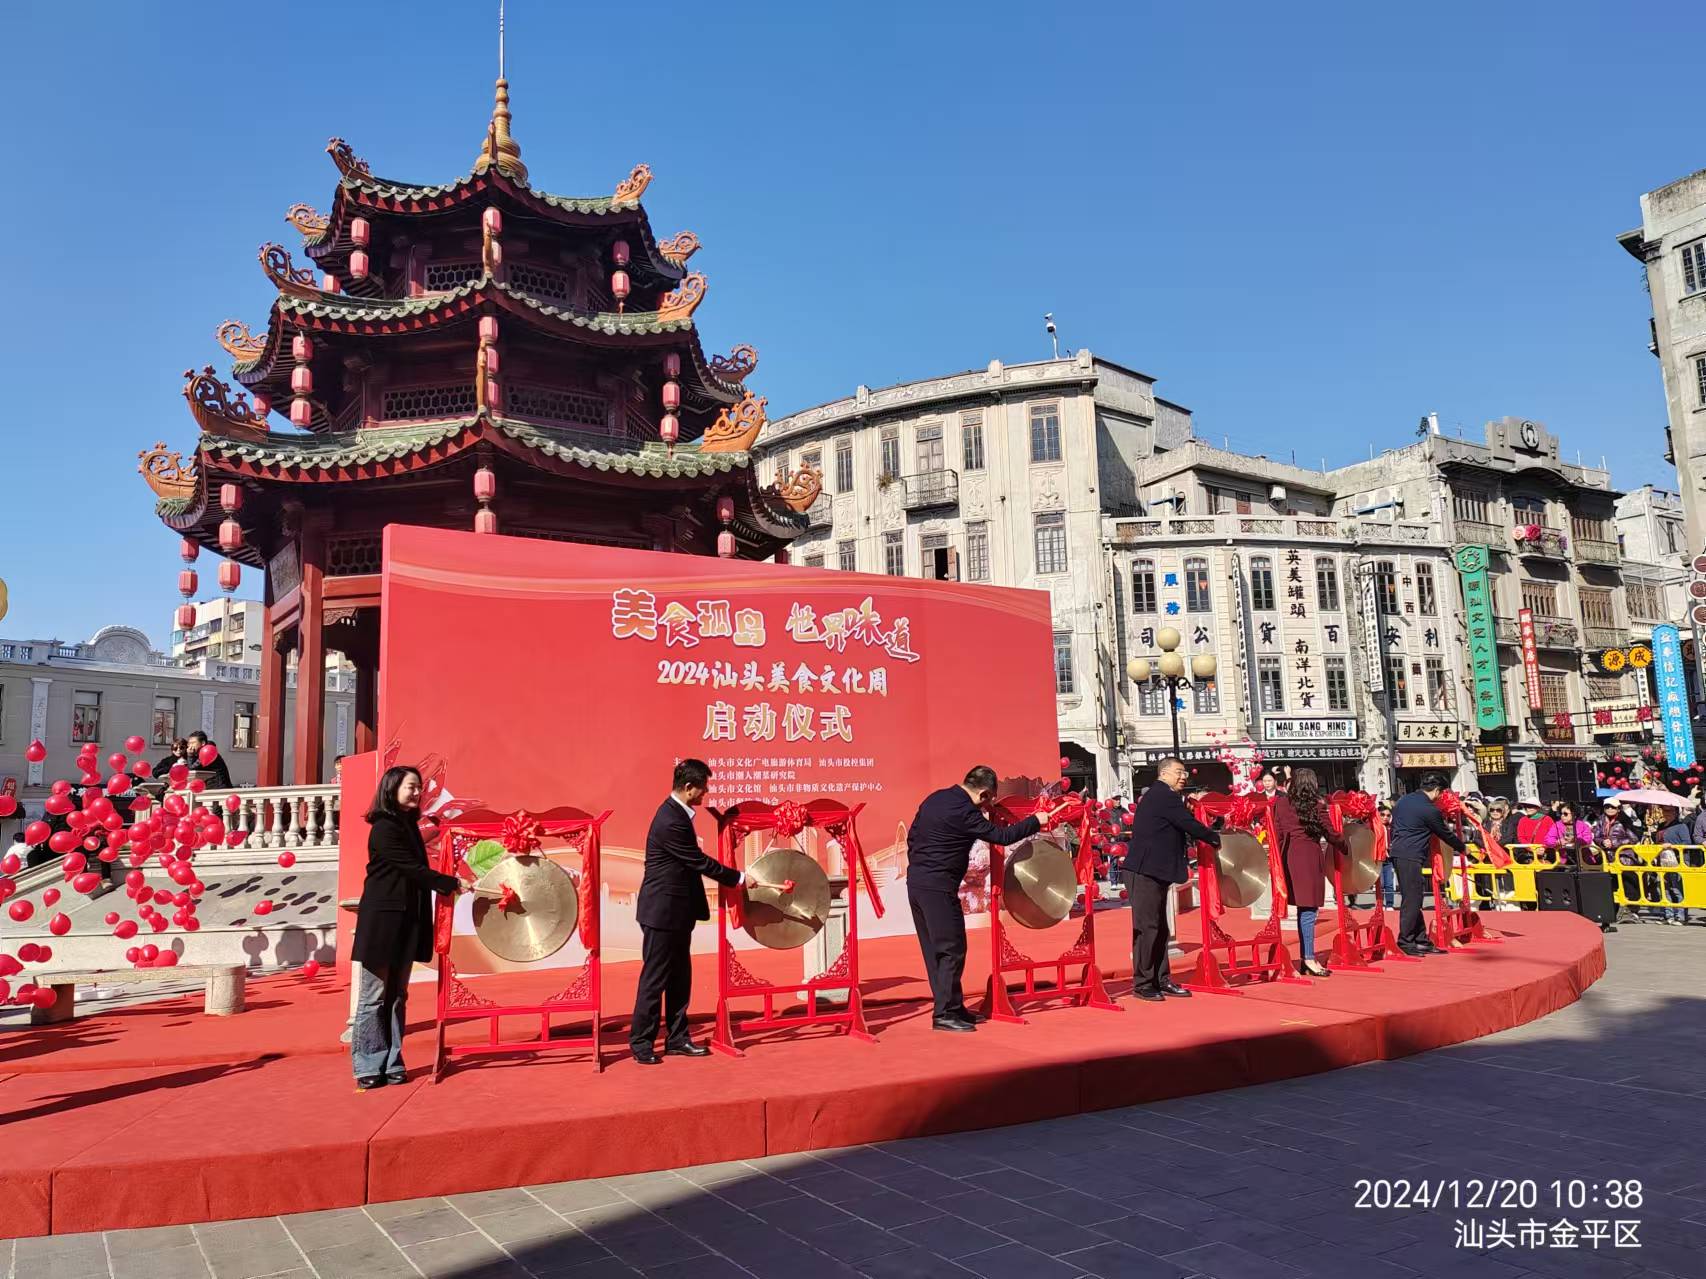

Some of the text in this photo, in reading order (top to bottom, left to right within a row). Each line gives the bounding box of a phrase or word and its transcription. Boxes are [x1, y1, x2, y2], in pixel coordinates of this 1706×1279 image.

[612, 588, 920, 662] 美食孤岛 世界味道
[1285, 549, 1314, 709] 英美罐頭 南洋北貨
[657, 659, 889, 697] 2024汕头美食文化周
[702, 702, 854, 742] 启动仪式
[1276, 721, 1293, 731] MAU
[1299, 721, 1321, 731] SANG
[1327, 721, 1347, 731] HING
[708, 757, 812, 767] 汕头市文化广电旅游体育局
[708, 782, 883, 794] 汕头市文化馆 汕头市非物质文化遗产保护中心
